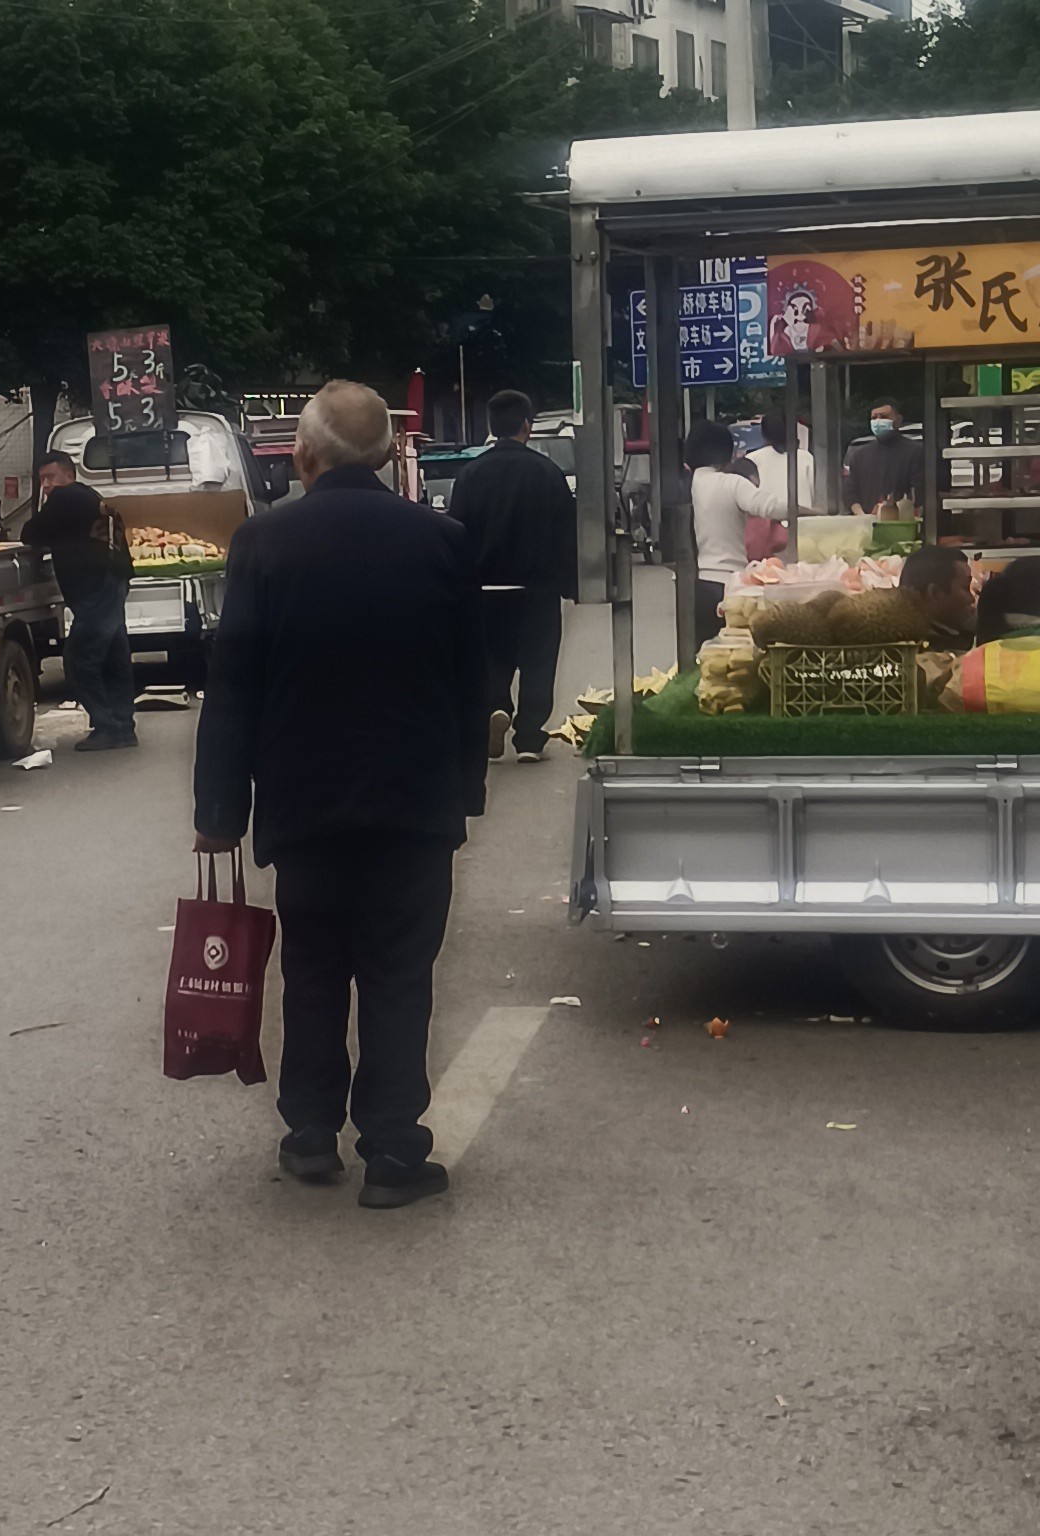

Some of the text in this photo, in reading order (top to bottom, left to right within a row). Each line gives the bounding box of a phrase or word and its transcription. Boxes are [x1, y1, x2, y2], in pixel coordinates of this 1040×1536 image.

[679, 291, 733, 315] 桥停车场
[914, 251, 1028, 333] 张氏
